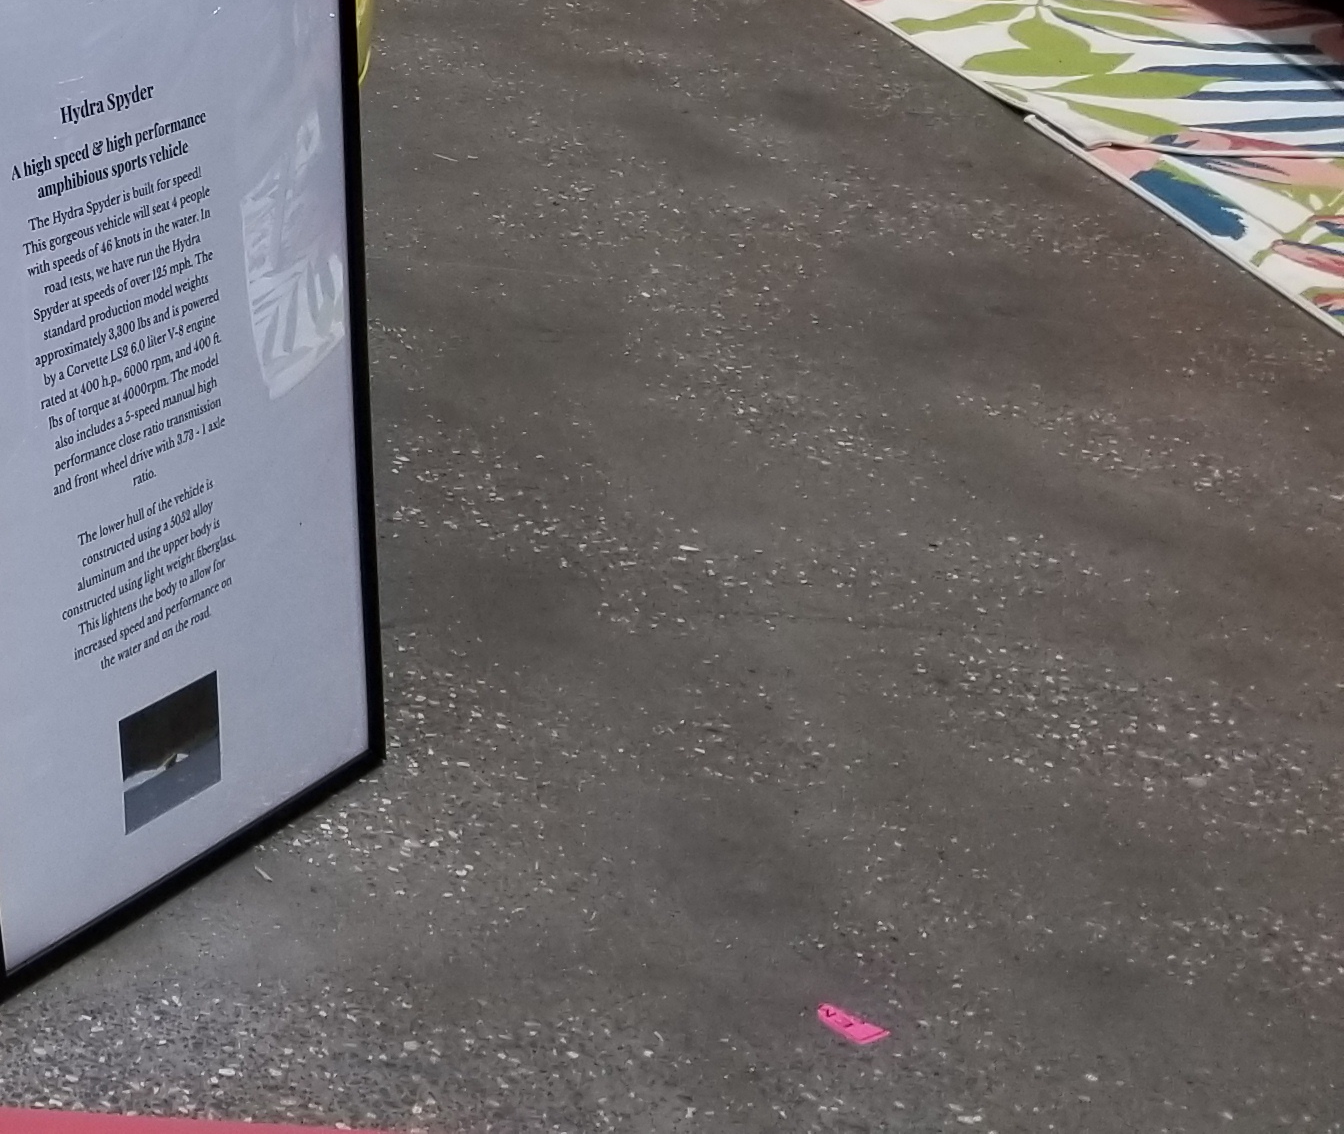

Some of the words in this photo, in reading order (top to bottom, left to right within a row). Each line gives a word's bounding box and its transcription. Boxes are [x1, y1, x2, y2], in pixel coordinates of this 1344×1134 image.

[59, 98, 105, 125] Hydra
[106, 83, 154, 112] Spyder
[10, 164, 22, 181] A
[22, 154, 52, 177] high
[53, 142, 90, 170] speed
[91, 139, 104, 157] &
[104, 130, 133, 153] high
[134, 111, 206, 148] performance
[36, 166, 109, 199] amphibious
[110, 154, 148, 179] sports
[148, 139, 189, 165] vehicle
[21, 238, 47, 256] This
[48, 225, 95, 252] gorgeous
[95, 211, 131, 233] vehicle
[131, 203, 150, 221] will
[151, 199, 170, 216] seat
[171, 195, 177, 208] 4
[178, 185, 210, 210] people
[26, 215, 50, 231] The
[51, 205, 84, 225] Hydra
[85, 193, 121, 216] Spyder
[122, 189, 131, 203] is
[131, 180, 155, 199] built
[155, 177, 171, 192] for
[26, 259, 51, 277] with
[51, 247, 86, 272] speeds
[87, 241, 99, 258] of
[100, 238, 113, 254] 46
[113, 231, 141, 250] knots
[142, 226, 153, 240] in
[154, 221, 170, 236] the
[170, 213, 199, 230] water.
[199, 207, 211, 221] In
[43, 275, 68, 295] road
[68, 270, 94, 287] tests,
[95, 264, 110, 278] we
[110, 256, 134, 273] have
[135, 250, 154, 265] run
[154, 243, 170, 258] the
[171, 233, 201, 253] Hydra
[32, 300, 70, 323] Spyder
[71, 296, 82, 309] at
[82, 282, 116, 307] speeds
[116, 276, 128, 293] of
[129, 272, 151, 288] over
[151, 263, 167, 281] 125
[193, 249, 213, 265] The
[42, 313, 86, 341] standard
[87, 298, 142, 329] production
[142, 282, 173, 306] model
[174, 273, 209, 294] weights
[34, 330, 107, 368] approximately
[107, 319, 136, 341] 3,300
[136, 315, 151, 330] lbs
[152, 305, 170, 325] and
[171, 304, 180, 318] is
[180, 287, 219, 318] powered
[42, 372, 56, 388] by
[58, 370, 65, 381] a
[65, 354, 108, 377] Corvette
[109, 343, 129, 363] LS2
[129, 337, 146, 355] 6.0
[146, 332, 167, 349] liter
[166, 323, 184, 340] V-8
[185, 314, 216, 334] engine
[40, 387, 67, 410] rated
[68, 387, 79, 400] at
[79, 377, 100, 395] 400
[123, 358, 149, 379] 6000
[174, 341, 192, 360] and
[193, 334, 211, 352] 400
[47, 415, 64, 430] lbs
[64, 406, 76, 423] of
[77, 398, 110, 419] torque
[111, 393, 121, 406] at
[121, 376, 169, 402] 4000rpm.
[169, 367, 189, 383] The
[190, 352, 219, 375] model
[53, 440, 116, 477] performance
[117, 430, 141, 448] close
[142, 419, 164, 438] ratio
[165, 397, 221, 429] transmission
[54, 434, 74, 450] also
[75, 418, 116, 442] includes
[117, 415, 124, 426] a
[124, 396, 161, 423] 5-speed
[161, 382, 196, 409] manual
[196, 375, 217, 394] high
[52, 476, 72, 496] and
[73, 468, 99, 488] front
[100, 454, 128, 477] wheel
[129, 447, 153, 465] drive
[154, 436, 175, 454] with
[176, 427, 194, 446] 3.73
[207, 415, 225, 433] axle
[132, 467, 157, 487] ratio.
[76, 530, 97, 546] The
[98, 518, 125, 538] lower
[125, 506, 145, 526] hull
[145, 500, 156, 517] of
[157, 497, 172, 512] the
[173, 481, 204, 505] vehicle
[205, 477, 213, 491] is
[81, 531, 136, 568] constructed
[136, 524, 162, 543] using
[162, 521, 168, 532] a
[169, 507, 191, 529] 5052
[192, 500, 213, 519] alloy
[61, 584, 116, 621] constructed
[117, 575, 143, 596] using
[143, 565, 165, 585] light
[165, 551, 195, 573] weight
[76, 562, 126, 592] aluminum
[127, 550, 145, 570] and
[145, 545, 161, 561] the
[162, 533, 189, 554] upper
[189, 521, 212, 541] body
[212, 517, 220, 530] is
[73, 627, 118, 661] increased
[119, 615, 145, 641] speed
[146, 606, 163, 626] and
[164, 582, 219, 621] performance
[220, 576, 232, 589] on
[76, 616, 100, 635] This
[100, 600, 137, 626] lightens
[138, 593, 153, 608] the
[154, 580, 177, 600] body
[177, 577, 188, 588] to
[188, 564, 211, 583] allow
[212, 558, 226, 572] for
[99, 655, 115, 670] the
[116, 641, 142, 661] water
[142, 629, 160, 649] and
[161, 626, 174, 640] on
[174, 619, 189, 633] the
